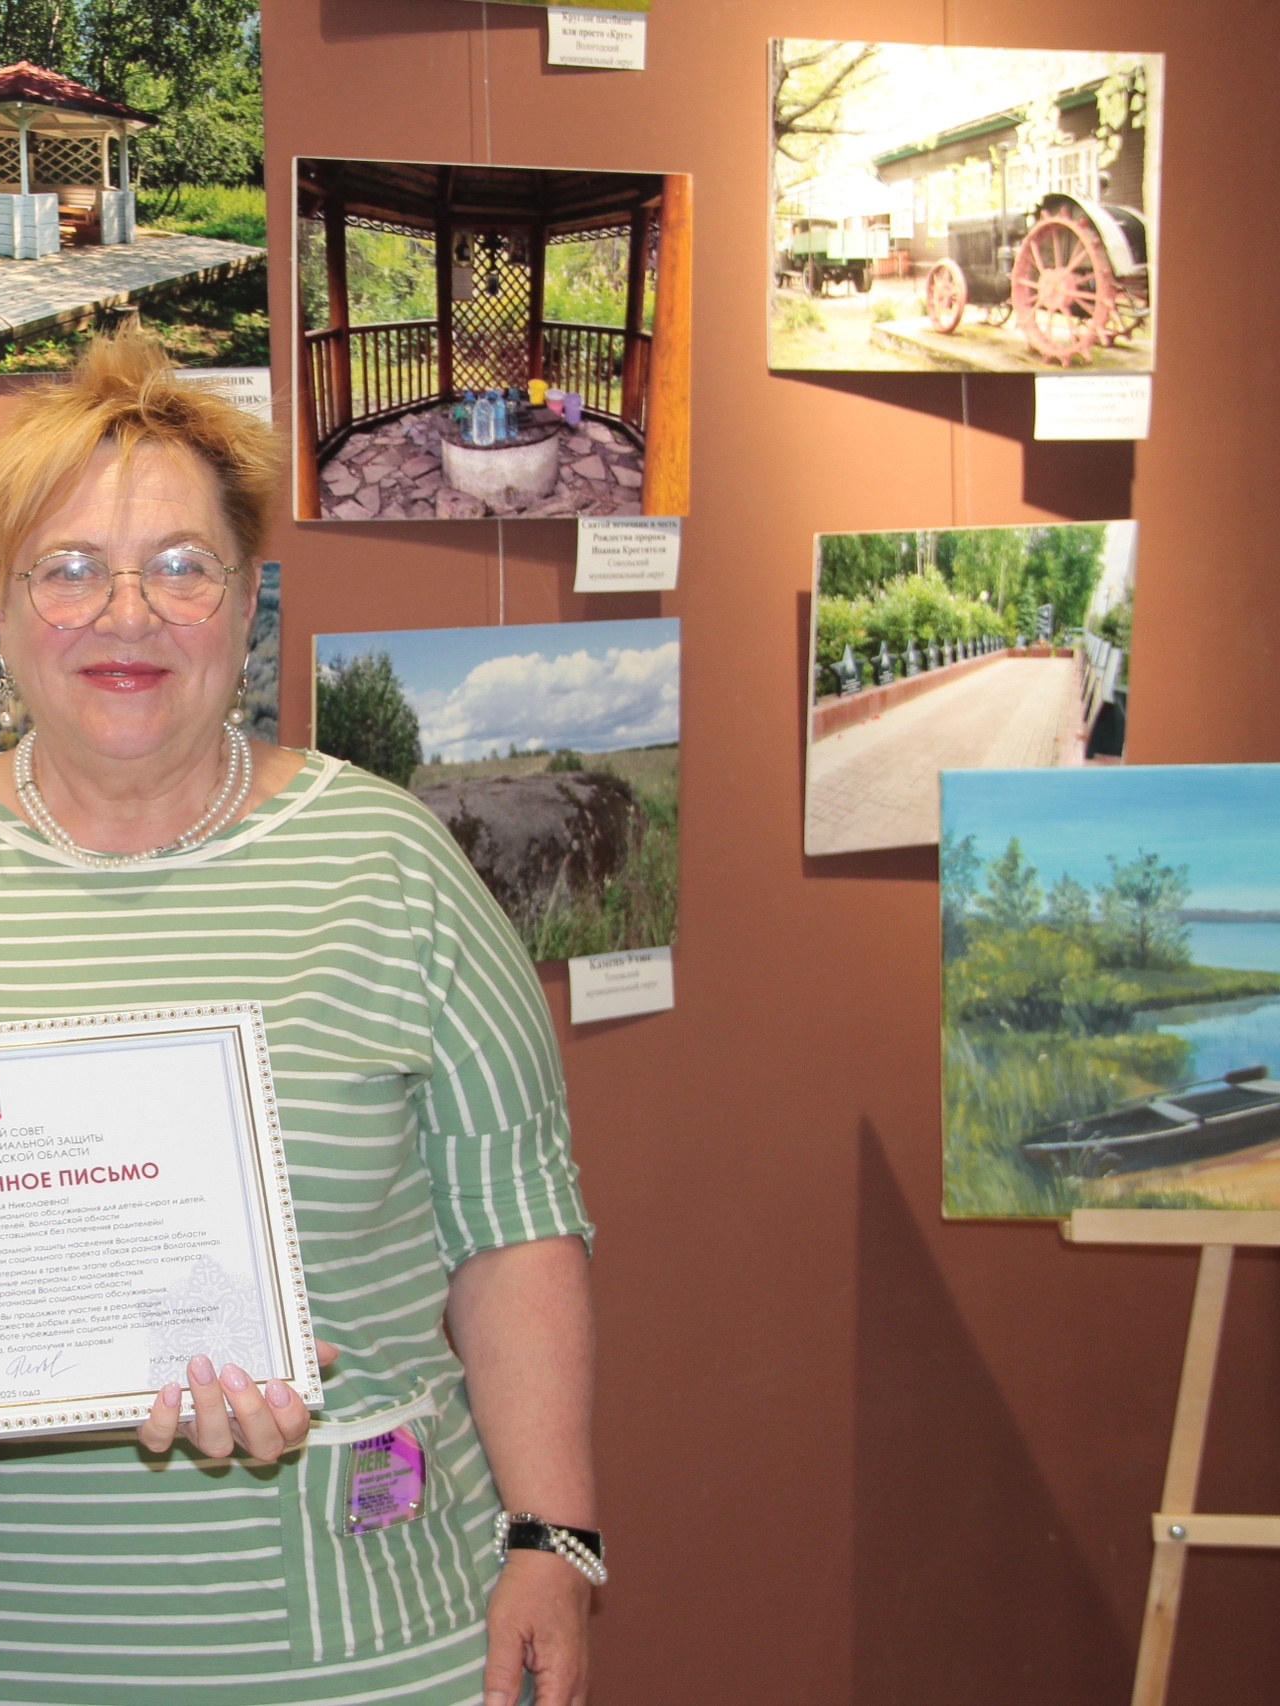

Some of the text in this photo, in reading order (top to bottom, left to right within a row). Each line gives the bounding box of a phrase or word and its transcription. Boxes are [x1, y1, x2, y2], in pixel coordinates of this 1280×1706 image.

[9, 1125, 44, 1137] СОВЕТ
[56, 1133, 104, 1146] ЗАЩИТЫ
[36, 1147, 90, 1160] ОБЛАСТИ
[58, 1161, 159, 1187] ПИСЬМО
[8, 1196, 69, 1209] Николаевна!
[40, 1205, 101, 1216] обслуживания
[117, 1199, 170, 1210] детей-сирот
[28, 1215, 83, 1228] Вологодской
[83, 1213, 120, 1222] области
[49, 1227, 65, 1235] без
[66, 1224, 111, 1233] попечения
[33, 1243, 66, 1252] защиты
[67, 1238, 114, 1248] населения
[115, 1232, 169, 1245] Вологодской
[171, 1230, 206, 1239] области
[8, 1253, 63, 1264] социального
[65, 1250, 100, 1259] проекта
[131, 1244, 161, 1254] разная
[45, 1265, 80, 1274] третьем
[82, 1262, 108, 1270] этапе
[109, 1257, 159, 1268] областного
[160, 1253, 202, 1263] конкурса
[20, 1276, 69, 1285] материалы
[78, 1269, 144, 1280] малоизвестных
[37, 1281, 92, 1294] Вологодской
[93, 1279, 132, 1289] области)
[48, 1292, 103, 1303] социального
[0, 1312, 12, 1320] Вы
[13, 1308, 66, 1320] продолжите
[67, 1305, 102, 1316] участие
[109, 1300, 162, 1312] реализации
[36, 1318, 69, 1328] добрых
[90, 1314, 120, 1323] будете
[121, 1309, 170, 1320] достойным
[172, 1305, 220, 1316] примером
[21, 1326, 74, 1340] учреждений
[76, 1322, 128, 1334] социальной
[129, 1320, 163, 1329] защиты
[7, 1342, 65, 1353] благополучия
[74, 1336, 114, 1347] здоровья!
[18, 1389, 40, 1397] года
